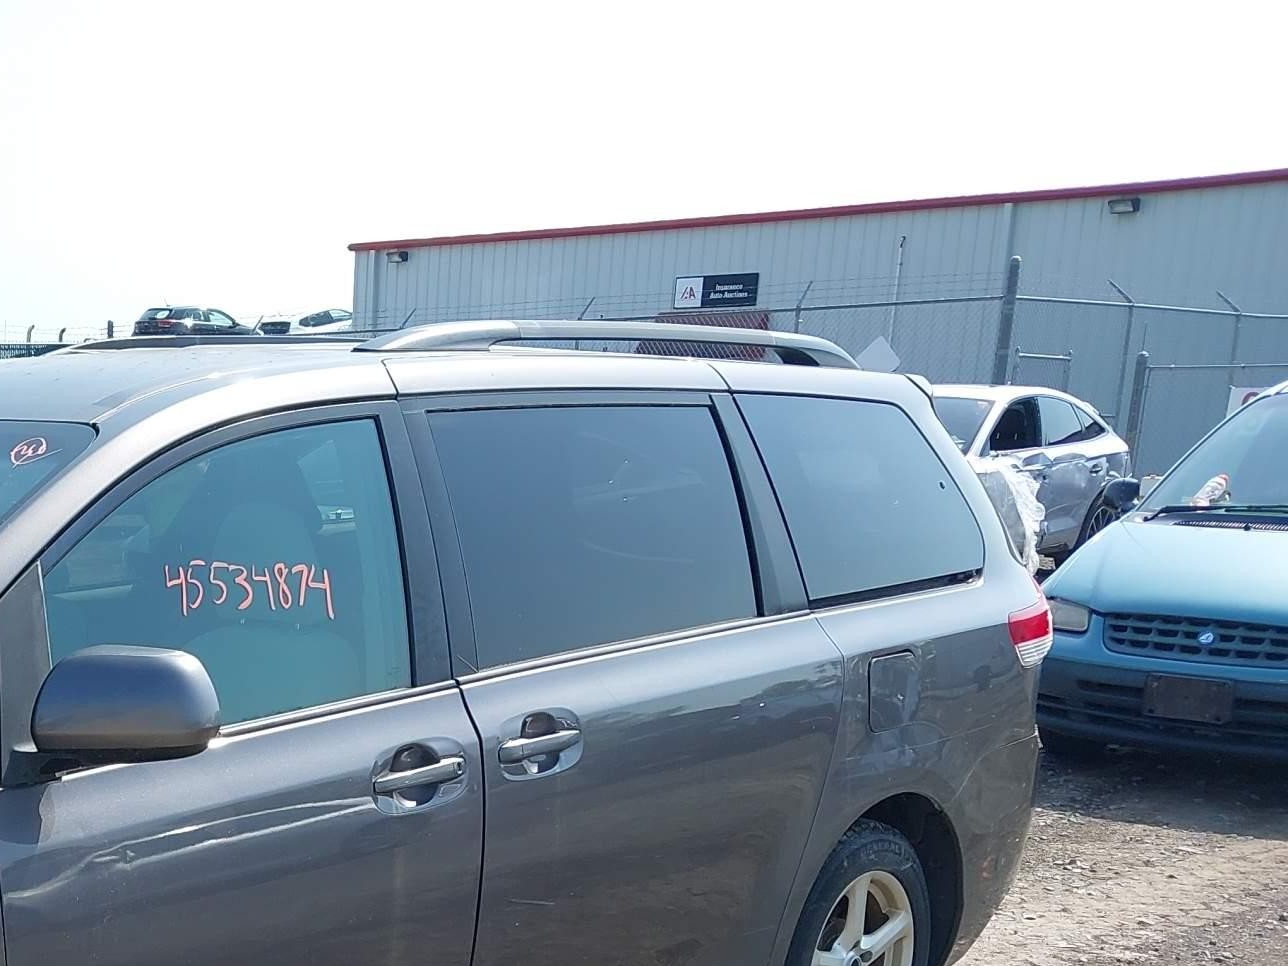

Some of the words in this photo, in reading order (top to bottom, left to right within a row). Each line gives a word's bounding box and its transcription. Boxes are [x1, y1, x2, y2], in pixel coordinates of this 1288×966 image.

[715, 283, 743, 291] Insurance
[723, 291, 748, 299] Auctions
[164, 559, 335, 621] 45534874
